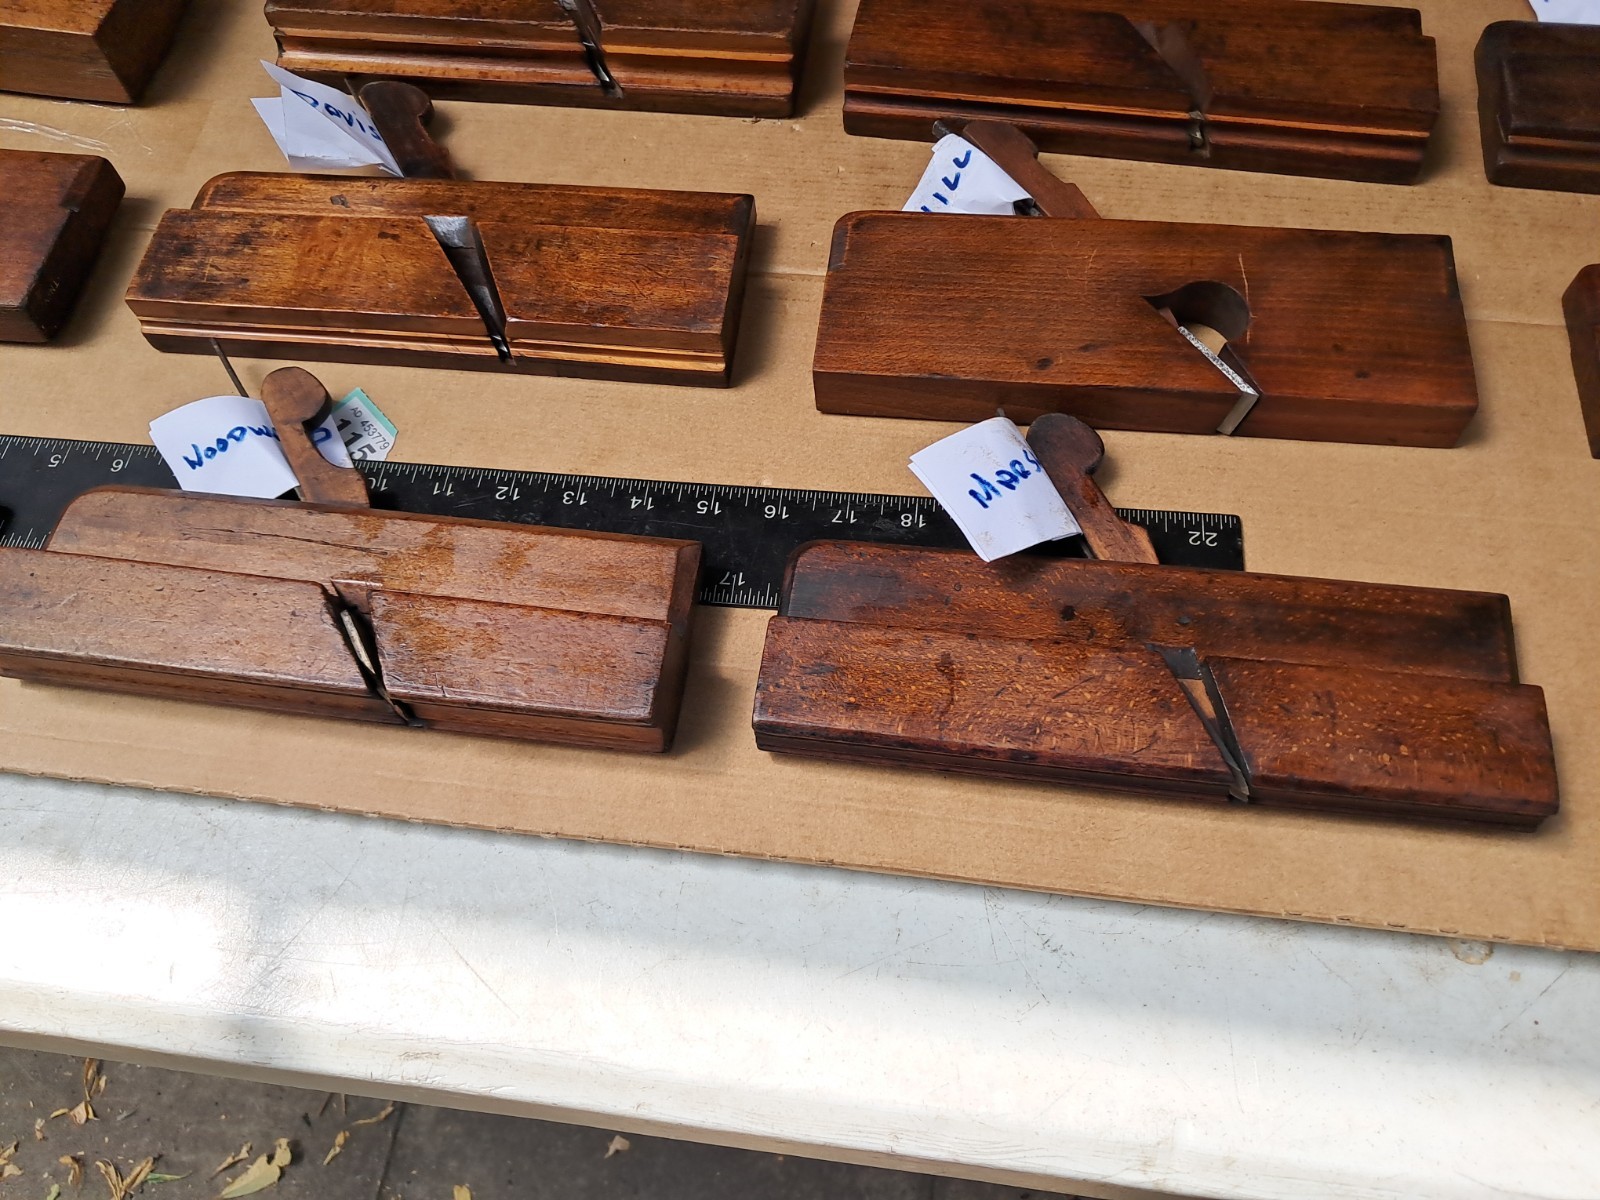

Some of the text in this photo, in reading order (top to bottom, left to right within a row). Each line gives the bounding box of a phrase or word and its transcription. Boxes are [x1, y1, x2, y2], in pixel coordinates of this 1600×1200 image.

[350, 406, 390, 451] AD 453779
[48, 454, 62, 468] 5
[110, 459, 124, 472] 6
[432, 482, 454, 497] 11
[495, 486, 521, 501] 12
[562, 491, 588, 506] 13
[630, 496, 655, 511] 14
[696, 501, 722, 515] 15
[764, 505, 790, 520] 16
[831, 510, 858, 524] 17
[900, 513, 927, 528] 18
[1188, 531, 1218, 547] 22
[720, 571, 746, 586] 17
